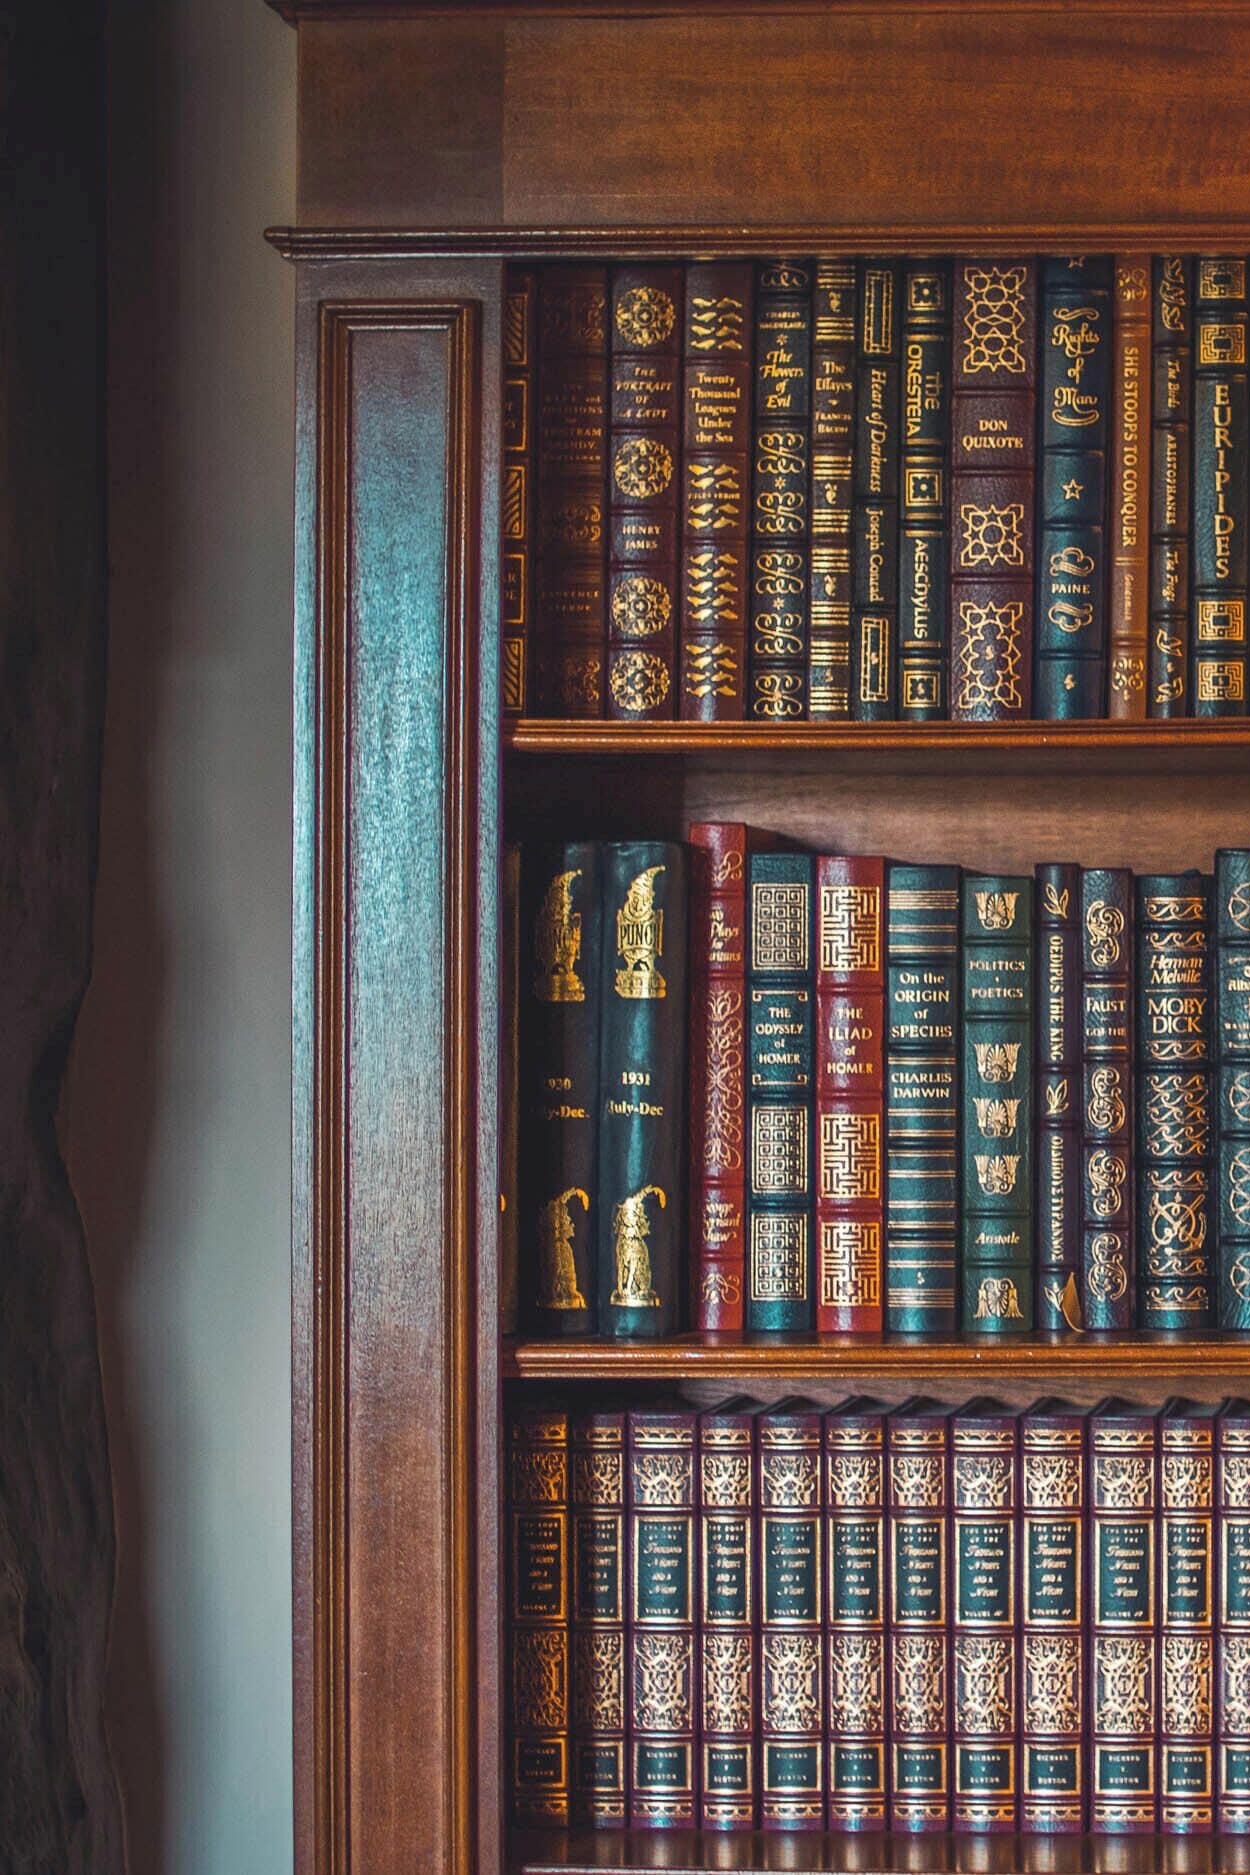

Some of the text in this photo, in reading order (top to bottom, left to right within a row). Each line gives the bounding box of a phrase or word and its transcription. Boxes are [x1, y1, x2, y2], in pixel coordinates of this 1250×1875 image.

[1051, 321, 1100, 358] Rights
[766, 349, 793, 363] The
[759, 364, 804, 378] Flowers
[822, 361, 846, 374] The
[1066, 356, 1084, 384] of
[696, 372, 735, 386] Twenty
[689, 387, 741, 399] Thousand
[775, 378, 790, 395] of
[906, 344, 923, 437] ORESTEIA
[767, 394, 792, 408] Evil
[1054, 386, 1098, 414] Man
[695, 402, 737, 416] Leagues
[698, 417, 733, 428] Under
[978, 419, 1008, 431] DON
[695, 431, 734, 443] the Sea
[865, 368, 888, 493] Heart of Darkness
[962, 435, 1024, 451] QUIXOTE
[1120, 346, 1139, 547] SHE STOOPS TO CONQUER
[1166, 433, 1178, 525] ARISTOPHANES
[1213, 384, 1235, 579] EURIPIDES
[622, 525, 661, 535] HENRY
[625, 540, 658, 550] JAMES
[865, 507, 885, 602] Joseph Conrad
[1051, 583, 1091, 594] PAINE
[969, 960, 1025, 971] POLITICS
[1150, 955, 1203, 969] Herman
[900, 972, 945, 984] On the
[1151, 969, 1201, 984] Melville
[894, 990, 950, 1003] ORIGIN
[971, 988, 1024, 999] POETICS
[1049, 935, 1064, 1062] OEDIPUS THE KING
[1086, 997, 1126, 1012] FAUST
[1148, 997, 1208, 1015] MOBY
[768, 1007, 791, 1018] THE
[836, 1008, 863, 1019] THE
[914, 1008, 928, 1020] of
[755, 1023, 804, 1035] ODYSSEY
[891, 1025, 953, 1038] SPECIES
[1152, 1016, 1203, 1034] DICK
[828, 1027, 873, 1040] ILIAD
[774, 1038, 785, 1048] of
[844, 1046, 856, 1056] of
[758, 1053, 801, 1064] HOMER
[827, 1062, 873, 1074] HOMER
[621, 1071, 651, 1086] 1931
[891, 1072, 953, 1083] CHARLES
[893, 1087, 950, 1098] DARWIN
[975, 1231, 1021, 1245] Aristotle
